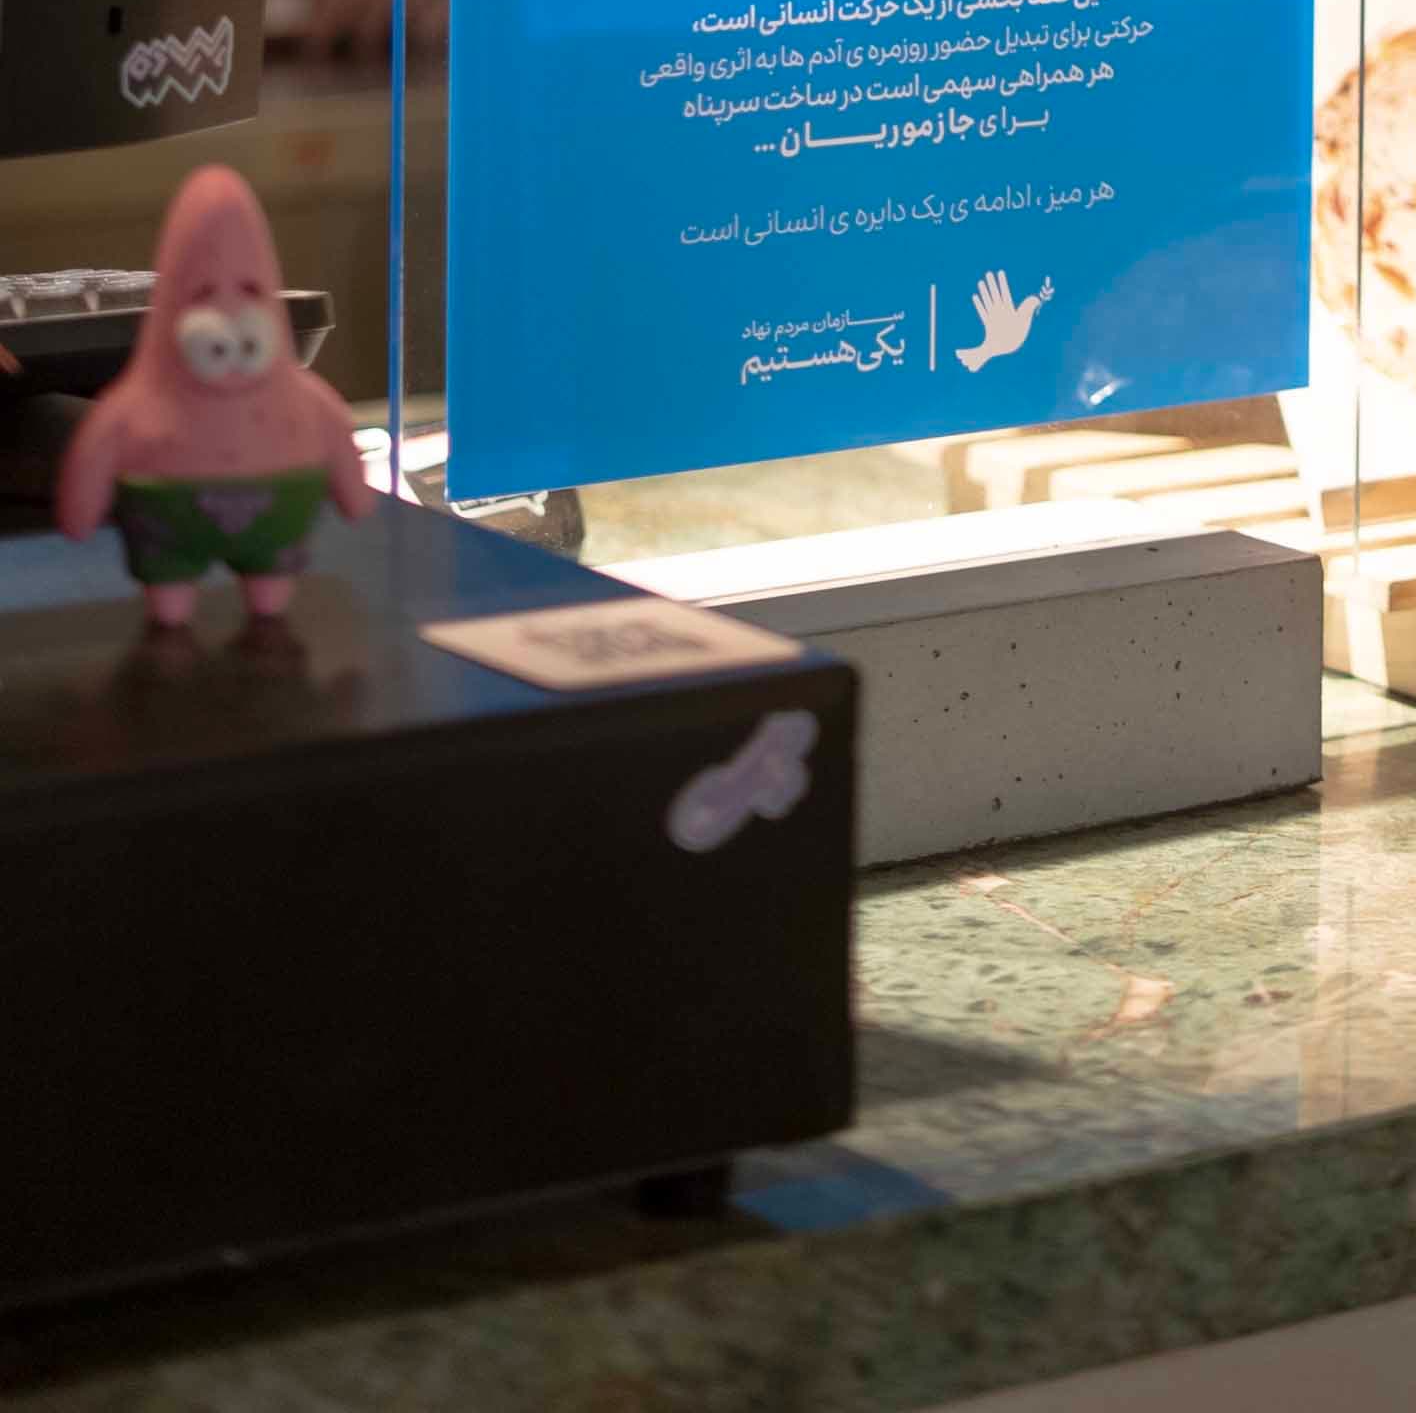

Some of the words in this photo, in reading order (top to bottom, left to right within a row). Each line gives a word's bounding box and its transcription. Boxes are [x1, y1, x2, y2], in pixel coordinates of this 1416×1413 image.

[931, 30, 991, 61] حضور
[994, 25, 1049, 56] تبدیل
[1052, 20, 1090, 49] برای
[1094, 16, 1154, 47] حرکتی
[640, 52, 706, 88] واقعی
[710, 47, 751, 80] اثری
[755, 53, 776, 75] به
[999, 61, 1084, 96] همراهی
[1086, 61, 1114, 88] هر
[764, 82, 836, 111] ساخت
[837, 84, 863, 111] در
[866, 73, 919, 101] است
[923, 73, 996, 104] سهمی
[911, 193, 945, 226] یک
[1085, 181, 1115, 209] هر
[679, 212, 739, 245] است
[744, 204, 825, 246] انسانی
[774, 321, 809, 342] مردم
